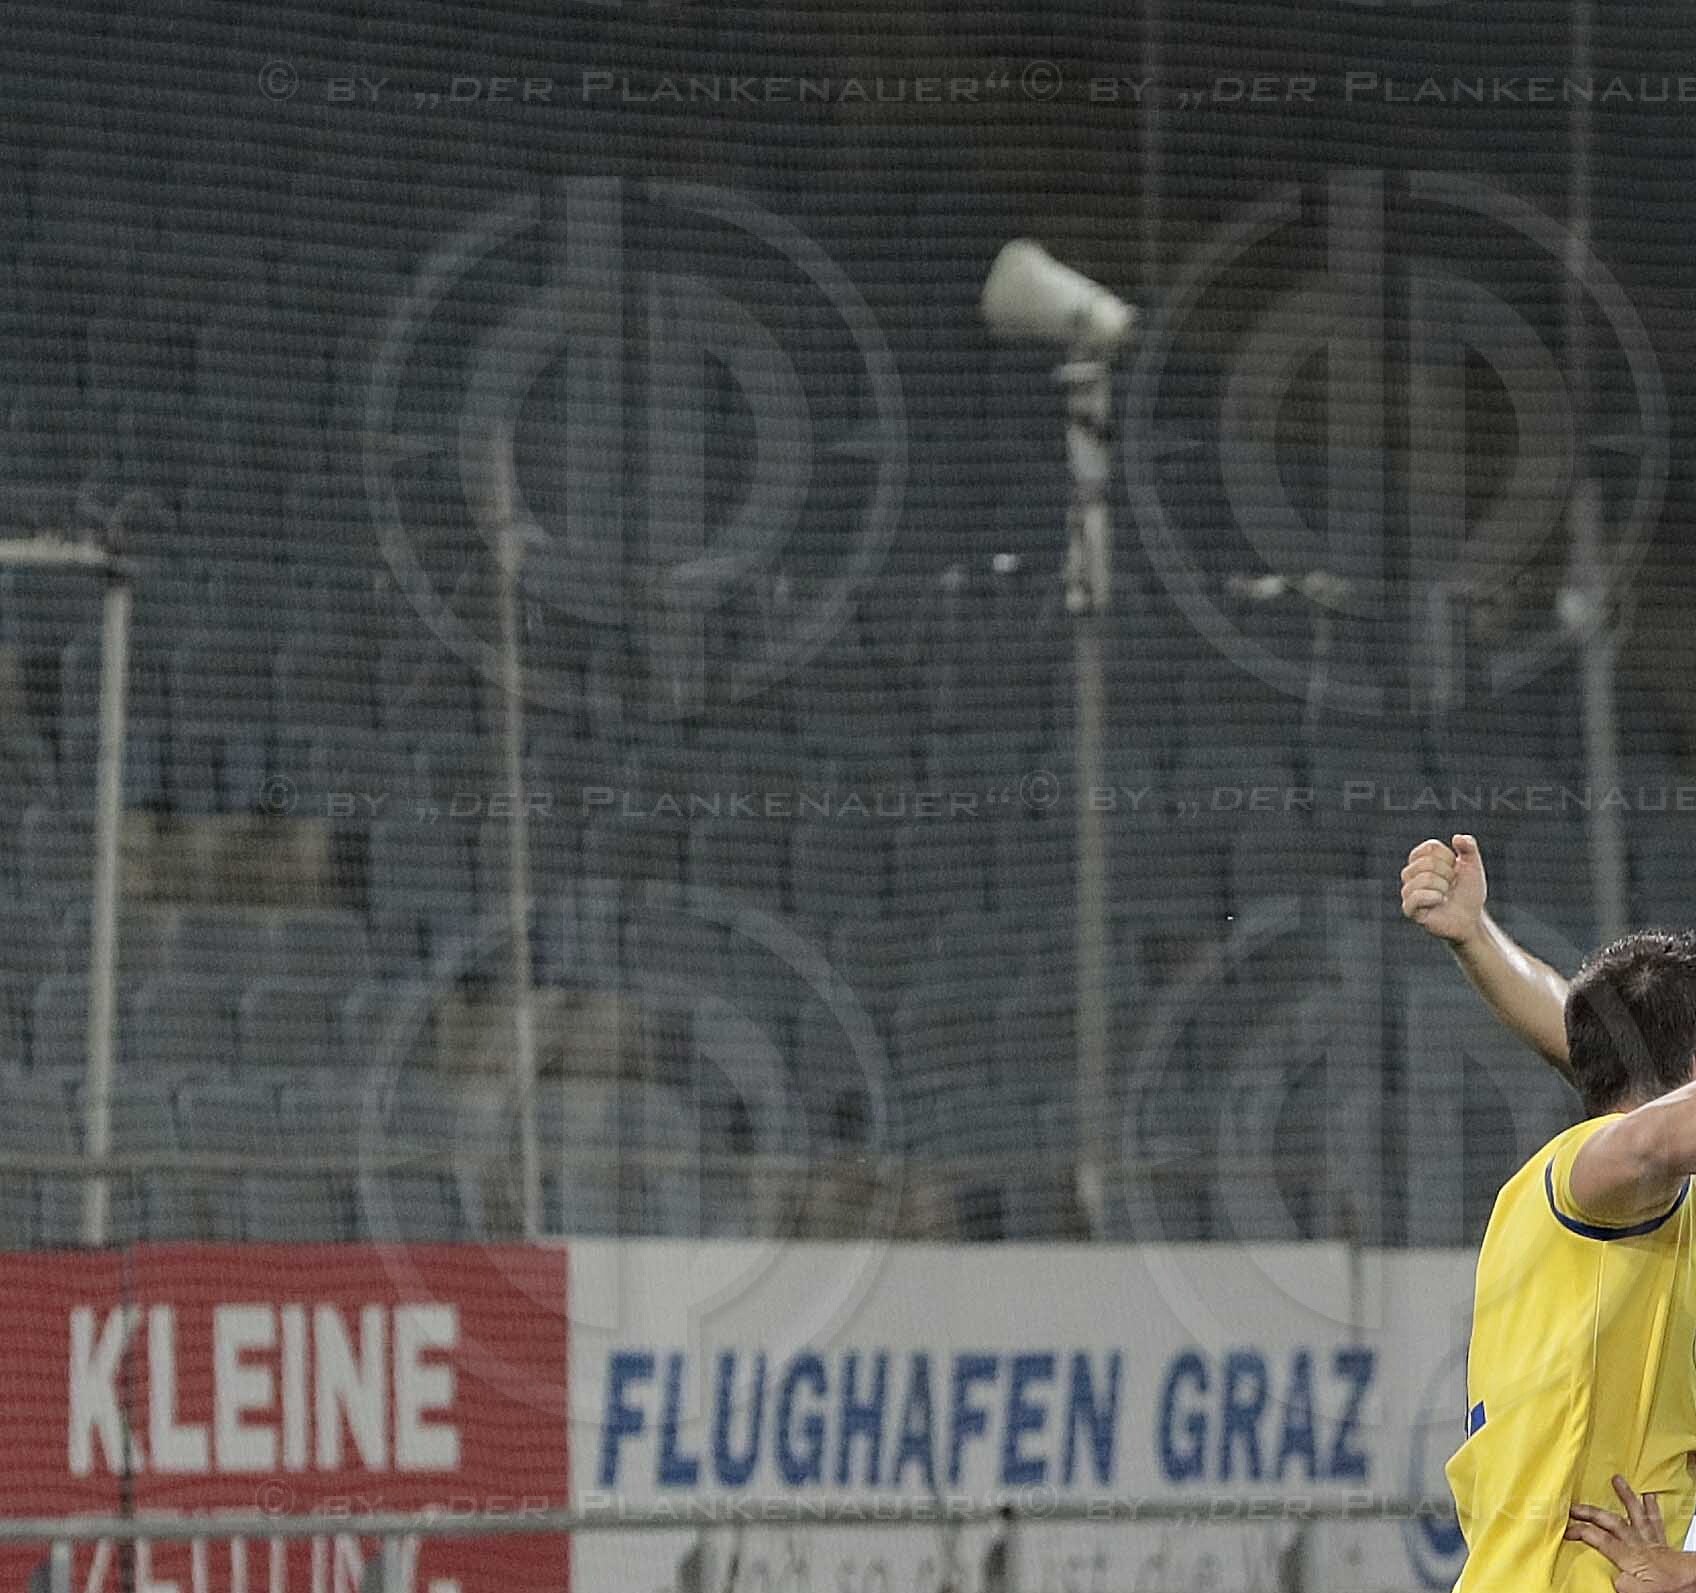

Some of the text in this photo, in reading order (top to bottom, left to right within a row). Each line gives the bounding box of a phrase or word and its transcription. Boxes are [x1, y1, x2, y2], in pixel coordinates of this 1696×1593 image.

[68, 1303, 461, 1476] KLEINE
[598, 1345, 1377, 1488] FLUGHAFEN GRAZ
